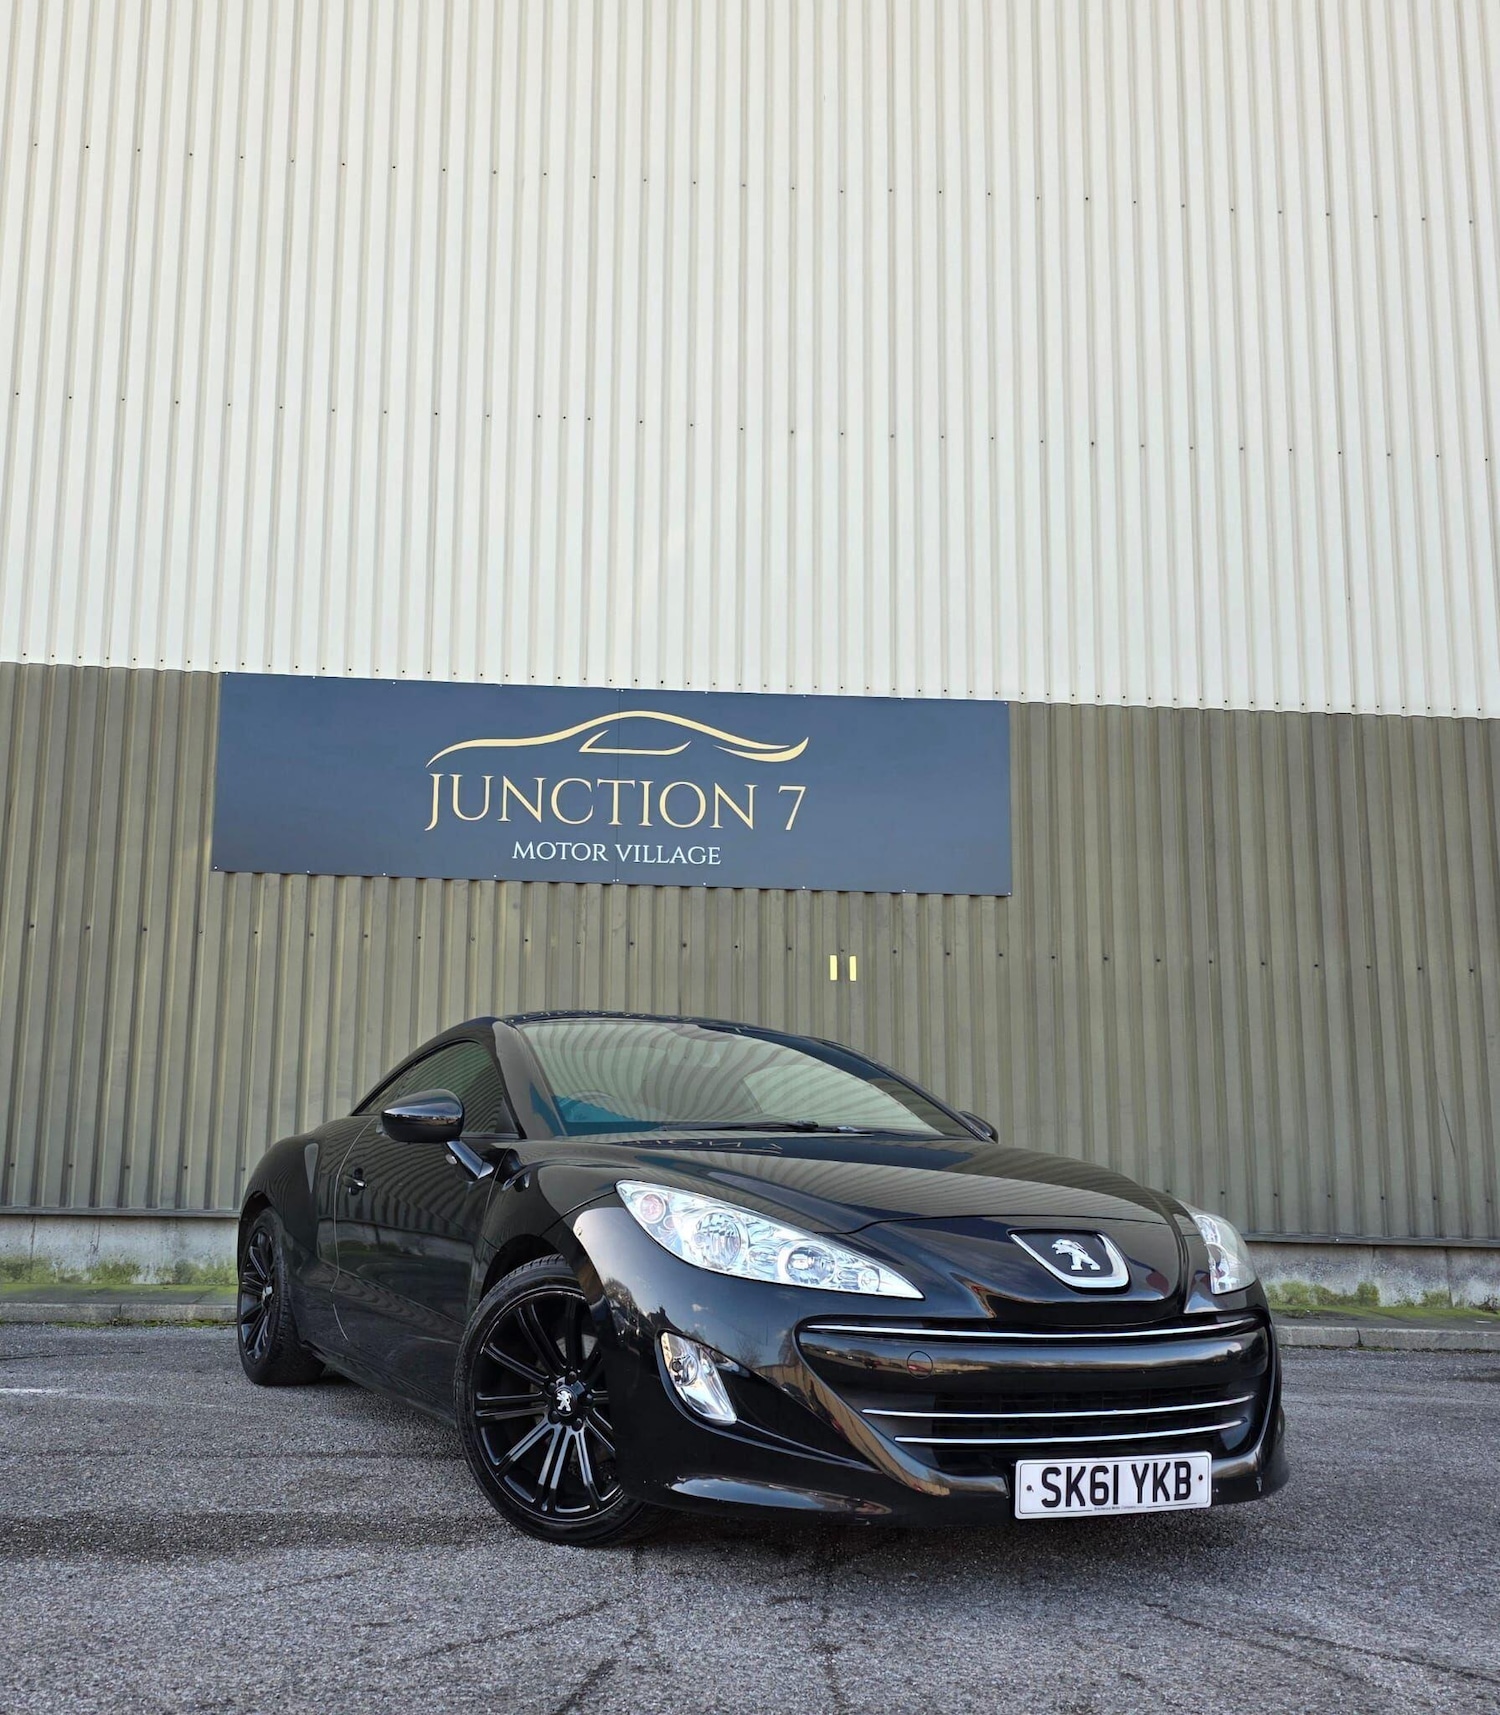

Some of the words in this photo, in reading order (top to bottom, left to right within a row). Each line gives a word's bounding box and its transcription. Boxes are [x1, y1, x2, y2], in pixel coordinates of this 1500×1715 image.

[425, 773, 758, 831] JUNCTION
[778, 785, 807, 831] 7
[512, 841, 607, 862] MOTOR
[615, 843, 722, 865] VILLAGE
[1041, 1464, 1119, 1508] SK61
[1131, 1461, 1191, 1504] YKB
